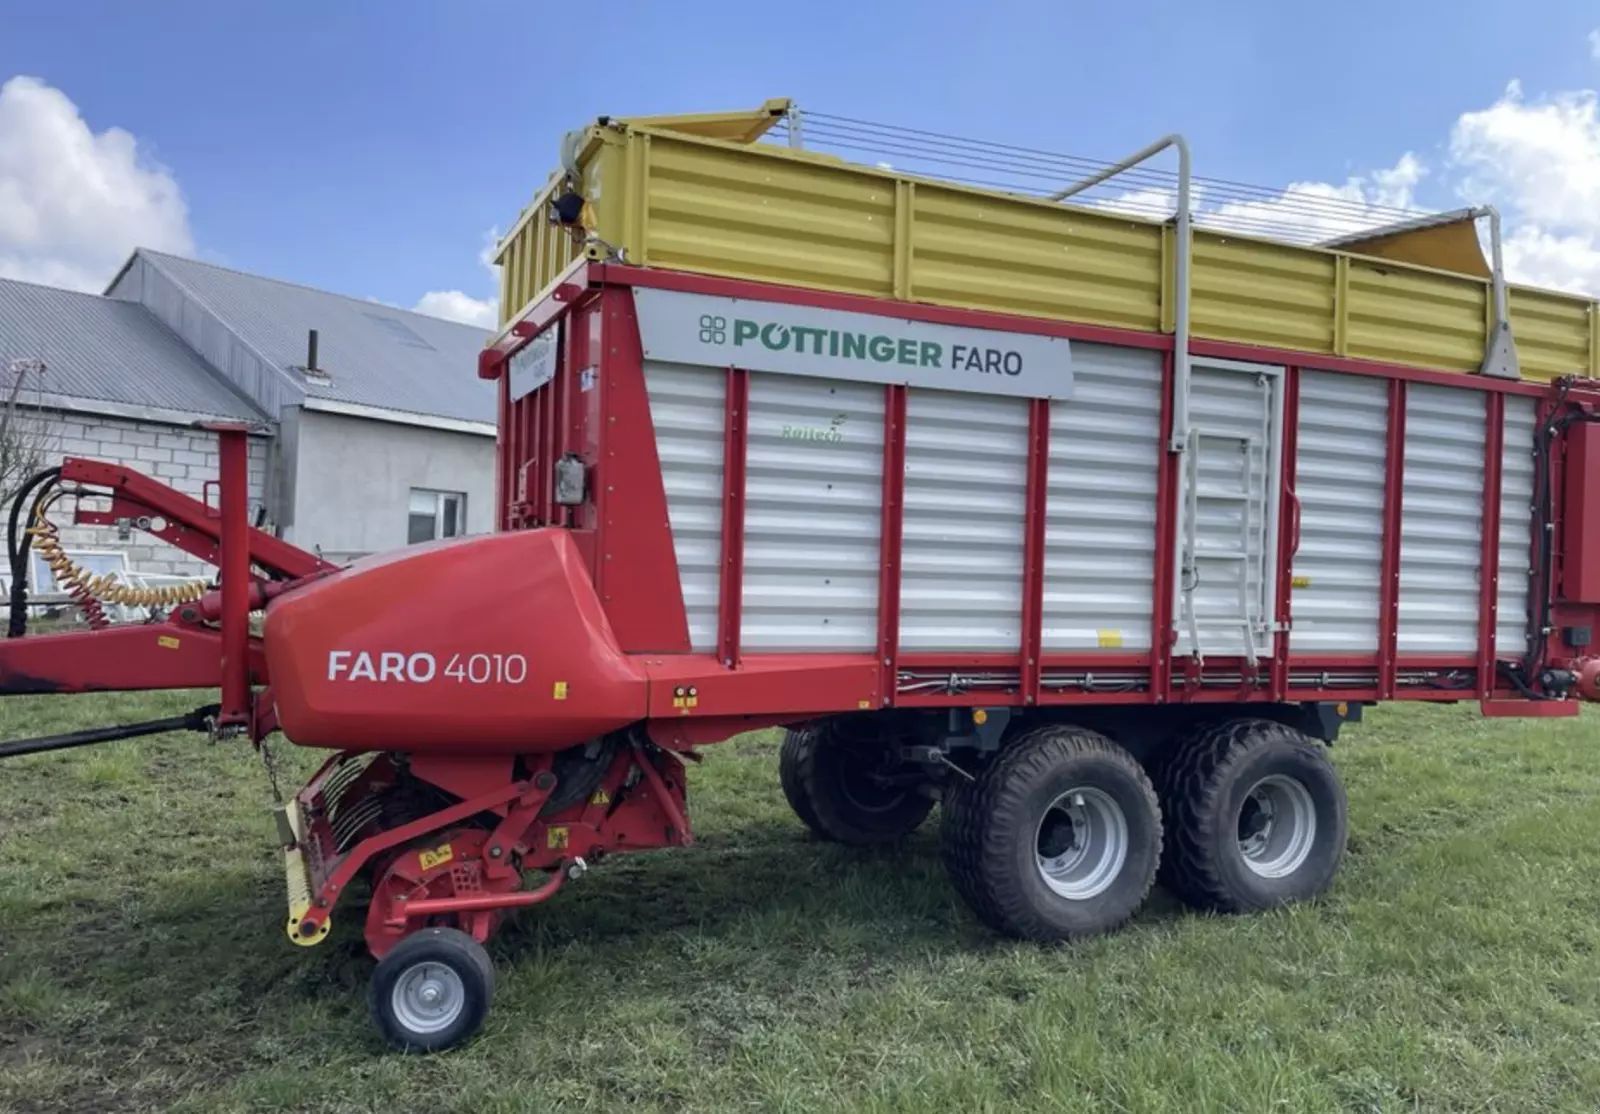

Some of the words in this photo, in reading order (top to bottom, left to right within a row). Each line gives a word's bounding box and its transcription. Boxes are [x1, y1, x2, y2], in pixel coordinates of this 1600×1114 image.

[733, 319, 942, 368] PÖTTINGER
[952, 345, 1023, 376] FARO
[327, 650, 436, 682] FARO
[444, 653, 527, 684] 4010
